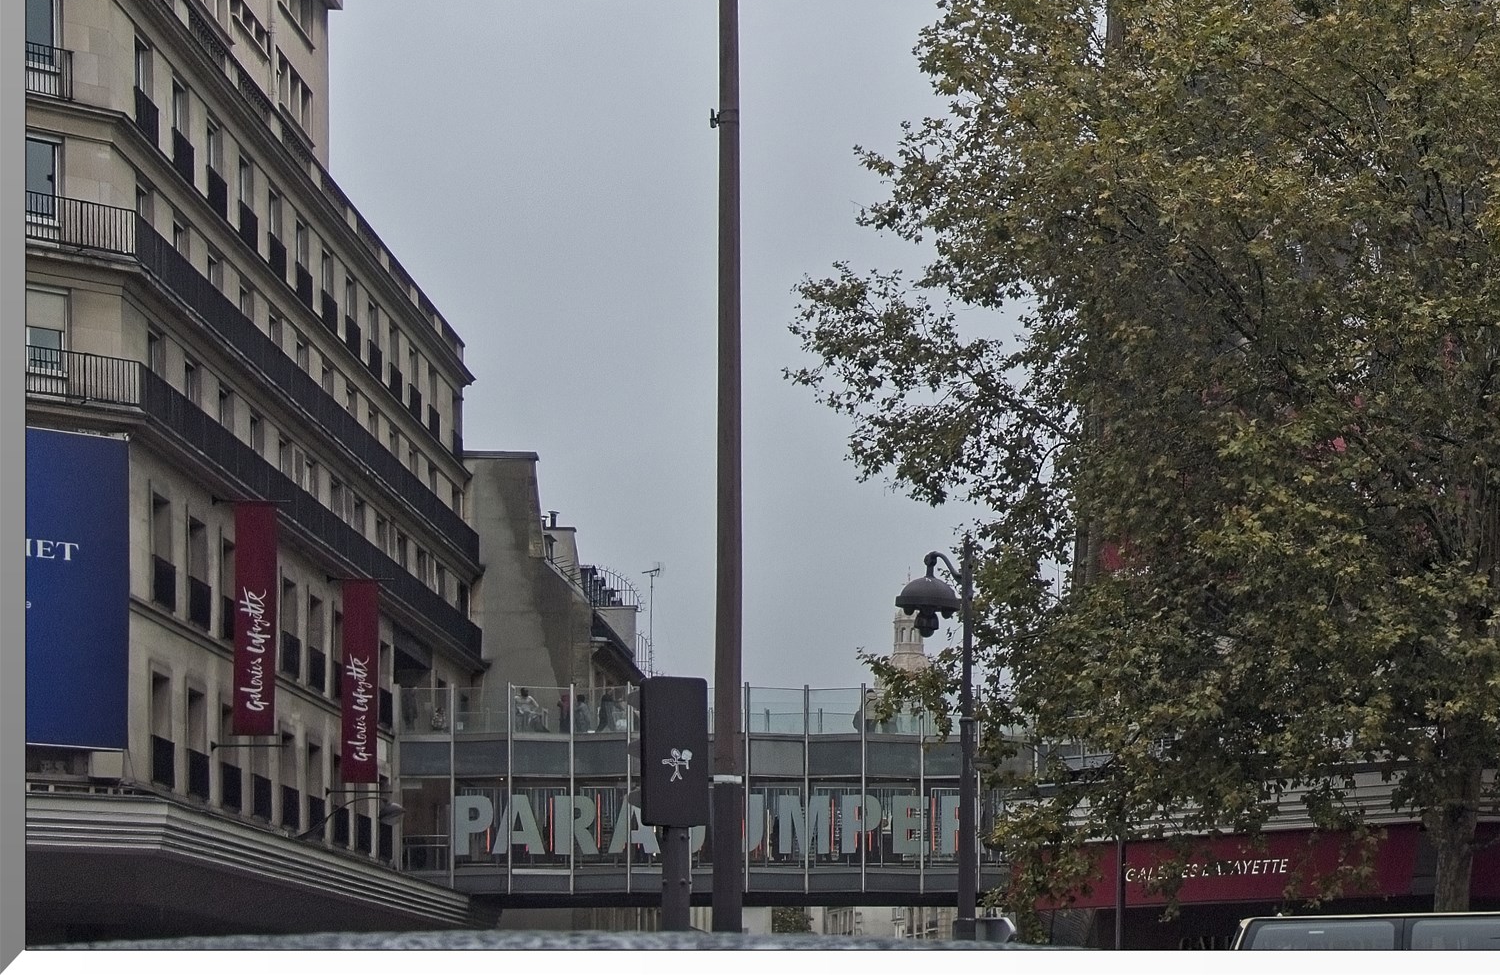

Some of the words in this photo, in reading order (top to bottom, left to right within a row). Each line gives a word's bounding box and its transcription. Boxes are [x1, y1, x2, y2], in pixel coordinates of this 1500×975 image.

[239, 586, 271, 654] Lafayette
[240, 657, 270, 711] Galeries
[346, 653, 373, 712] Lafayette
[347, 714, 372, 761] Galeries
[1125, 863, 1198, 882] GALEES
[1202, 858, 1289, 877] LAAYETTE
